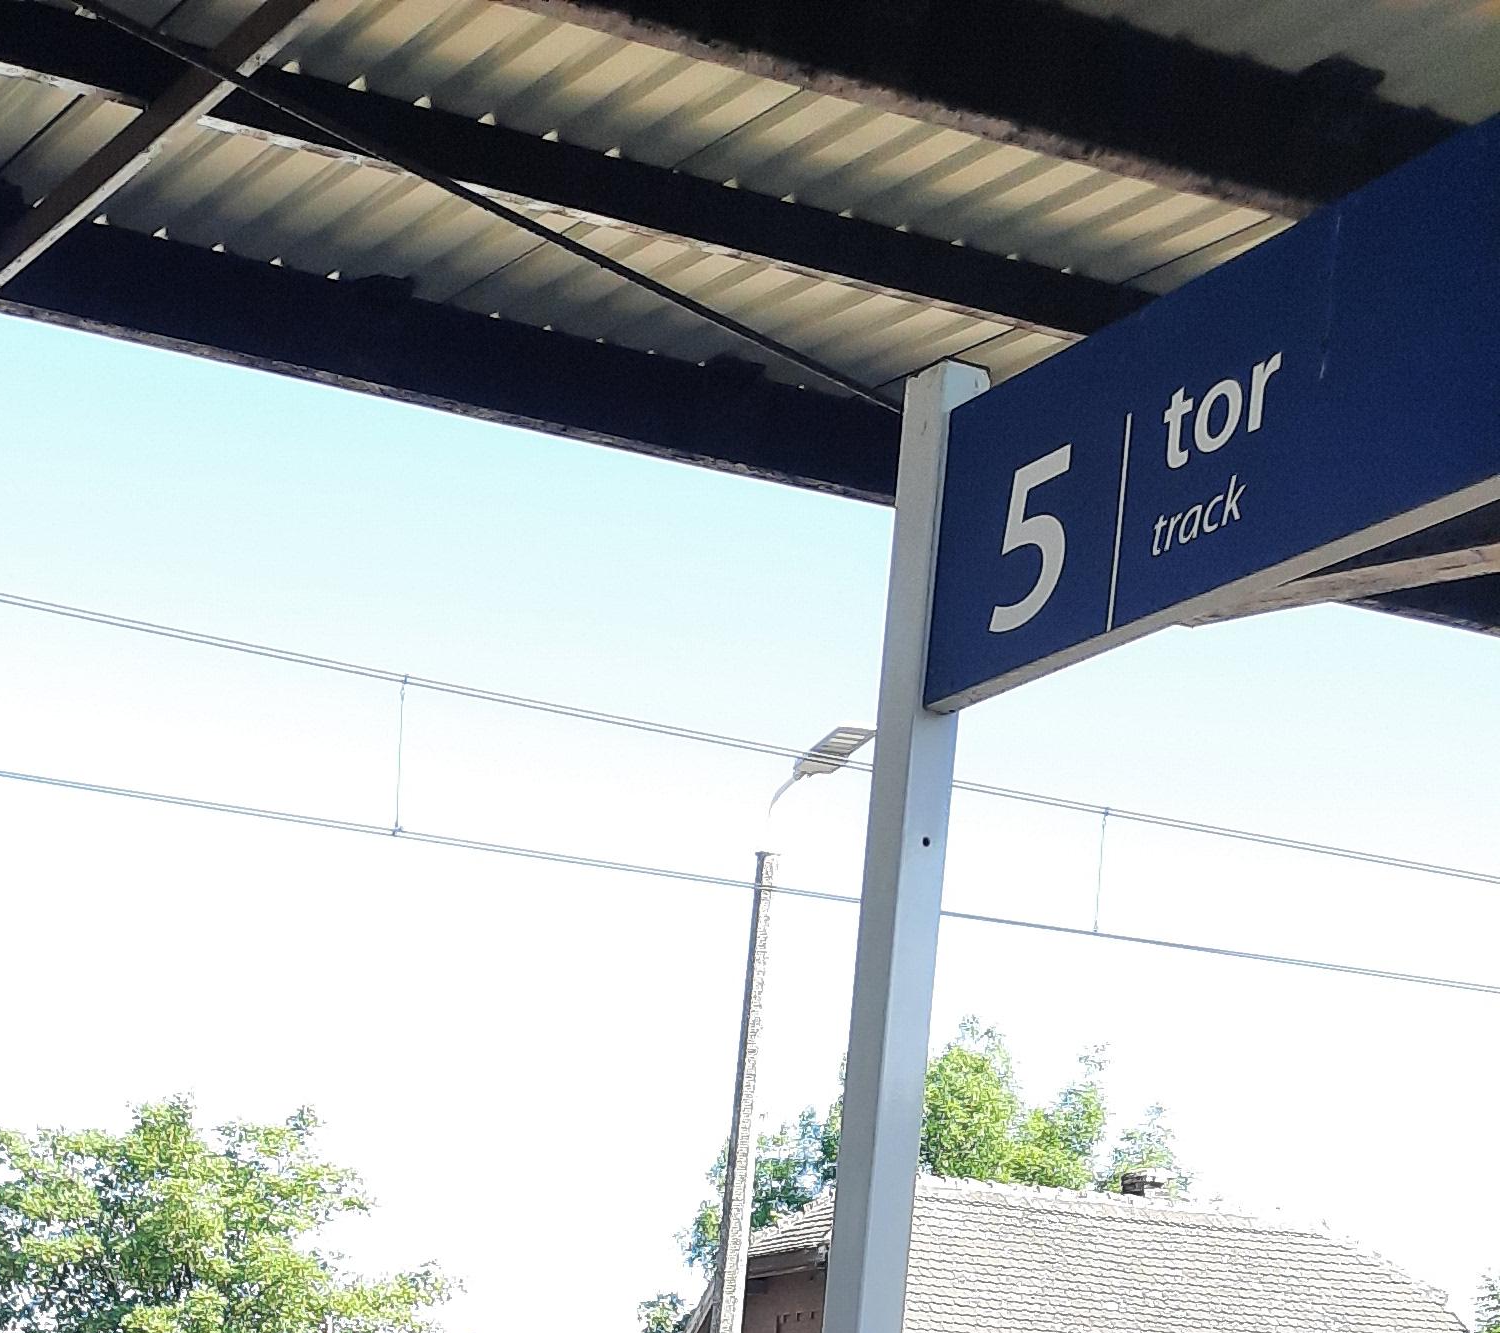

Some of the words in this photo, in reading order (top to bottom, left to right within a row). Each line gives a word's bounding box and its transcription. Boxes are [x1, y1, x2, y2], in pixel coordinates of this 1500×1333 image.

[1162, 351, 1283, 470] tor
[988, 443, 1072, 634] 5
[1150, 474, 1247, 557] track
